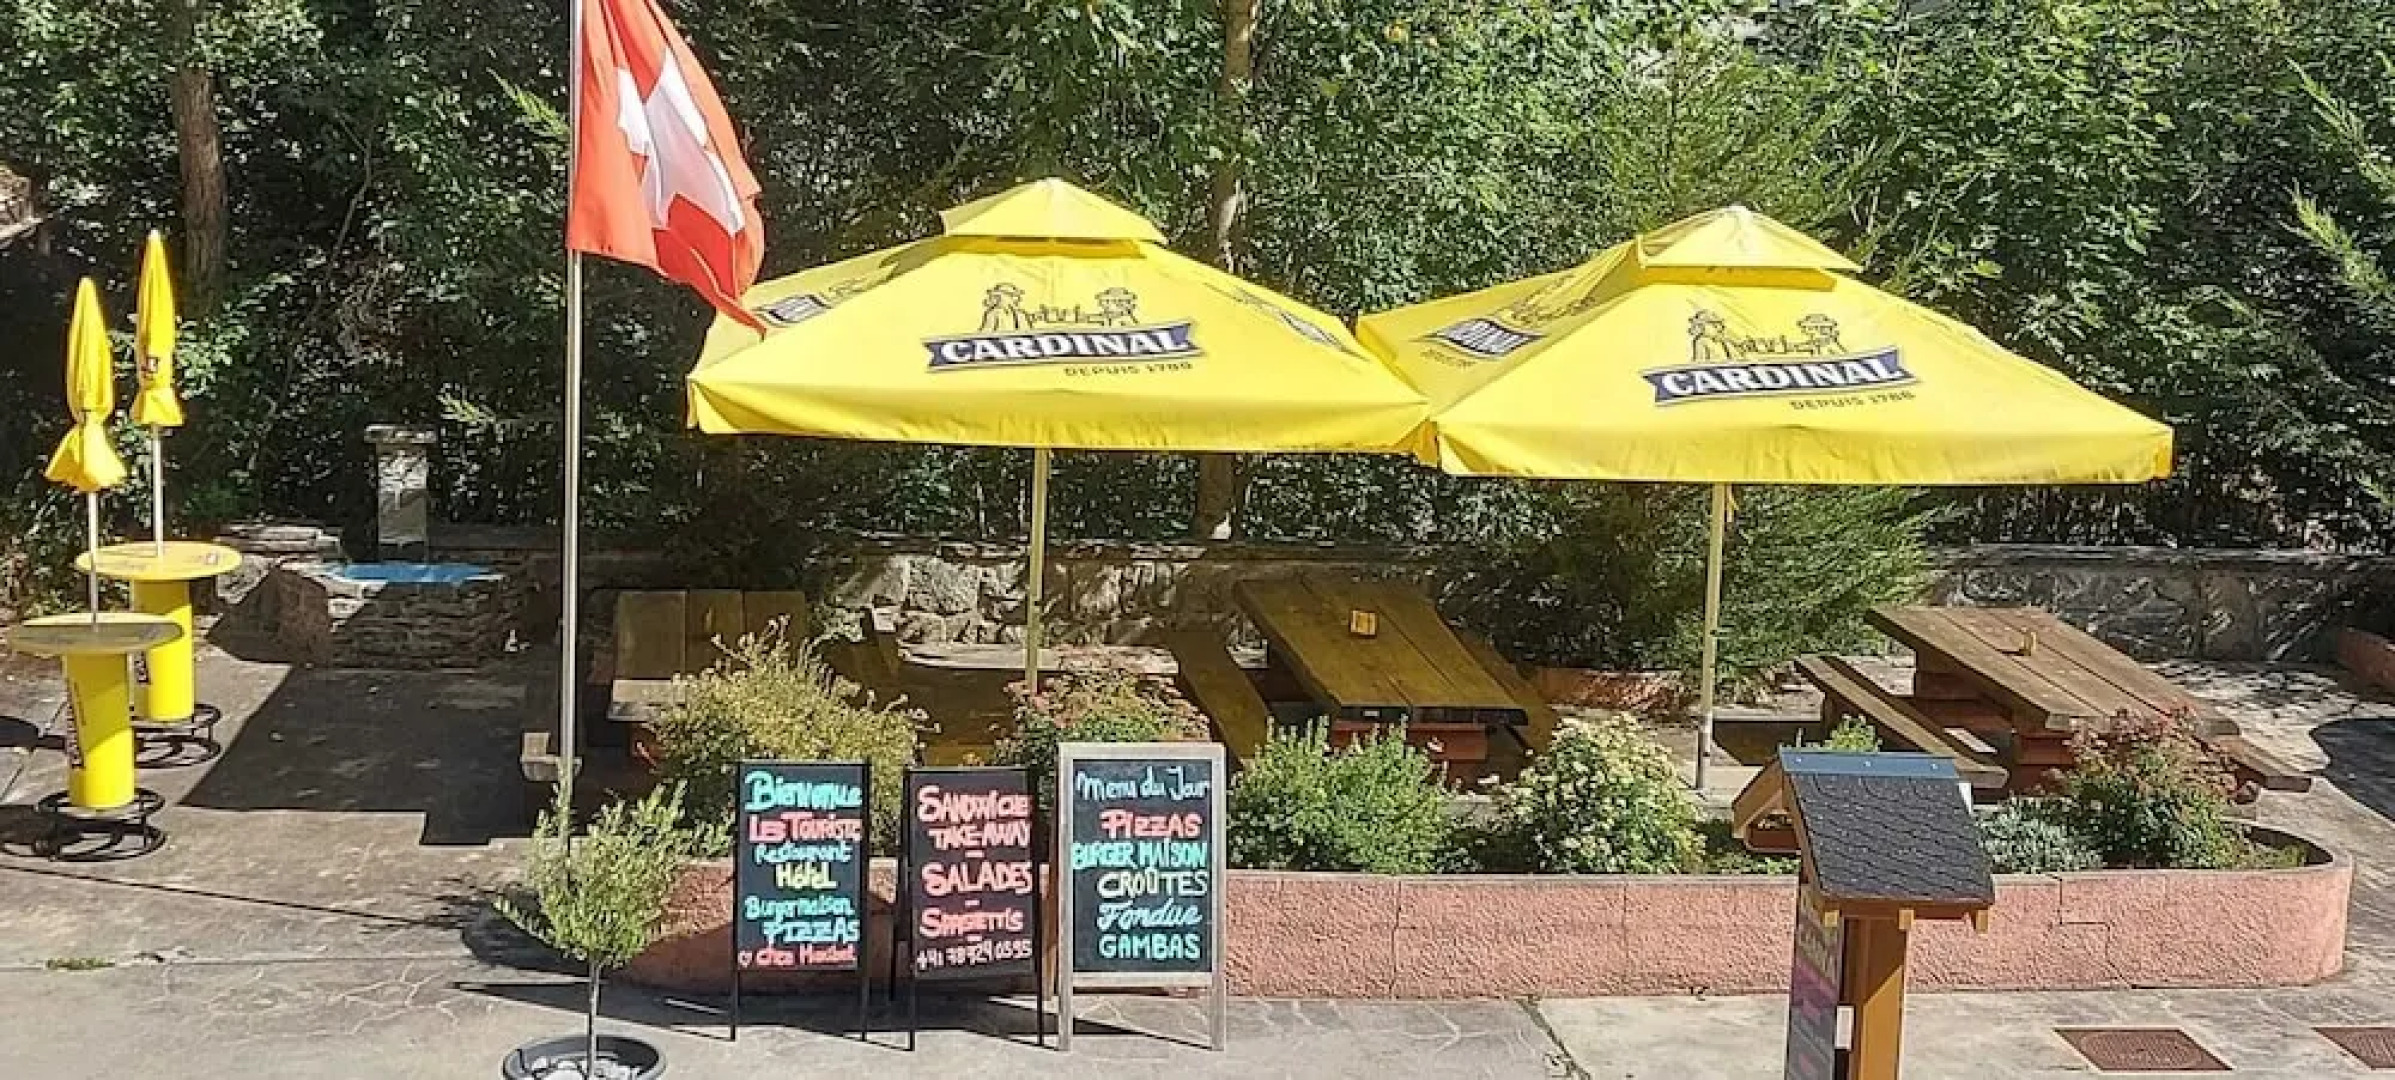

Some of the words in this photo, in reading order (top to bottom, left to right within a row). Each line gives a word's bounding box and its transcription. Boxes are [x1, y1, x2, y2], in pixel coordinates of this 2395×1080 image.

[939, 329, 1190, 364] CARDINAL
[1063, 365, 1141, 378] DEPUIS
[1660, 357, 1904, 396] CARDINAL
[1789, 396, 1865, 410] DEPUIS
[744, 770, 863, 811] Bienvenue
[1077, 770, 1138, 800] Menu
[1140, 765, 1165, 797] du
[1099, 808, 1204, 838] PIZZAS
[1072, 842, 1138, 870] BURGER
[921, 861, 1033, 896] SALADES
[763, 915, 861, 945] PIZZAS
[1097, 898, 1203, 931] Fondue
[1100, 933, 1201, 960] GAMBAS
